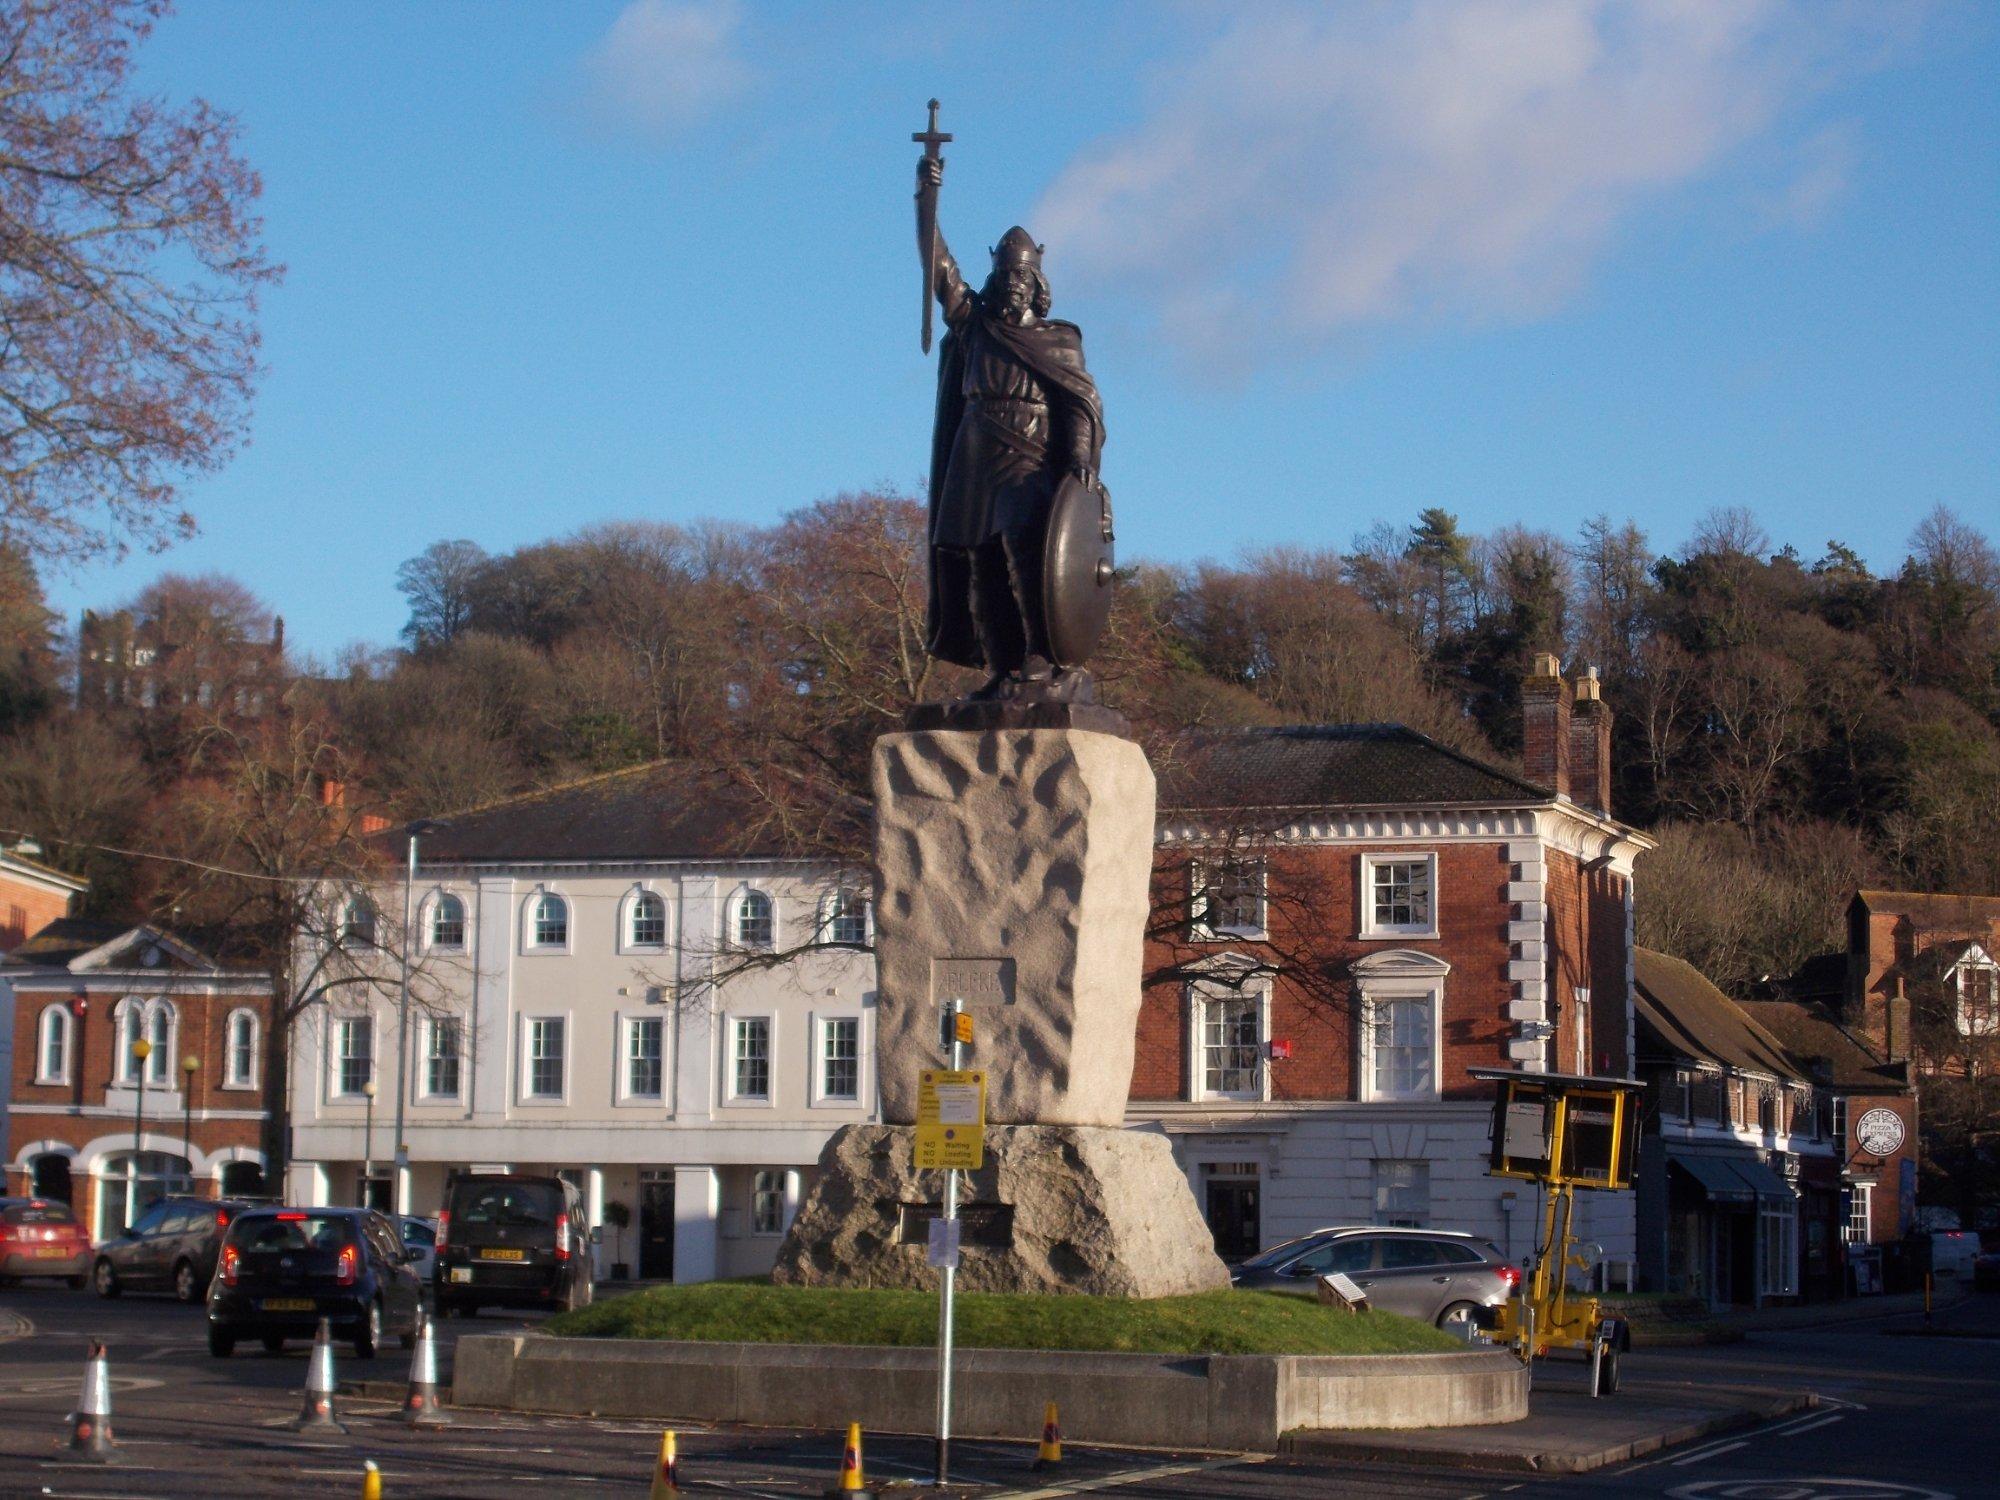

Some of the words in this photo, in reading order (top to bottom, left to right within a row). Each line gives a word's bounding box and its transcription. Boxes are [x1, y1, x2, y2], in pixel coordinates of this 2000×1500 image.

[945, 1142, 970, 1150] Waiting
[923, 1149, 935, 1157] NO
[945, 1150, 971, 1158] Loading
